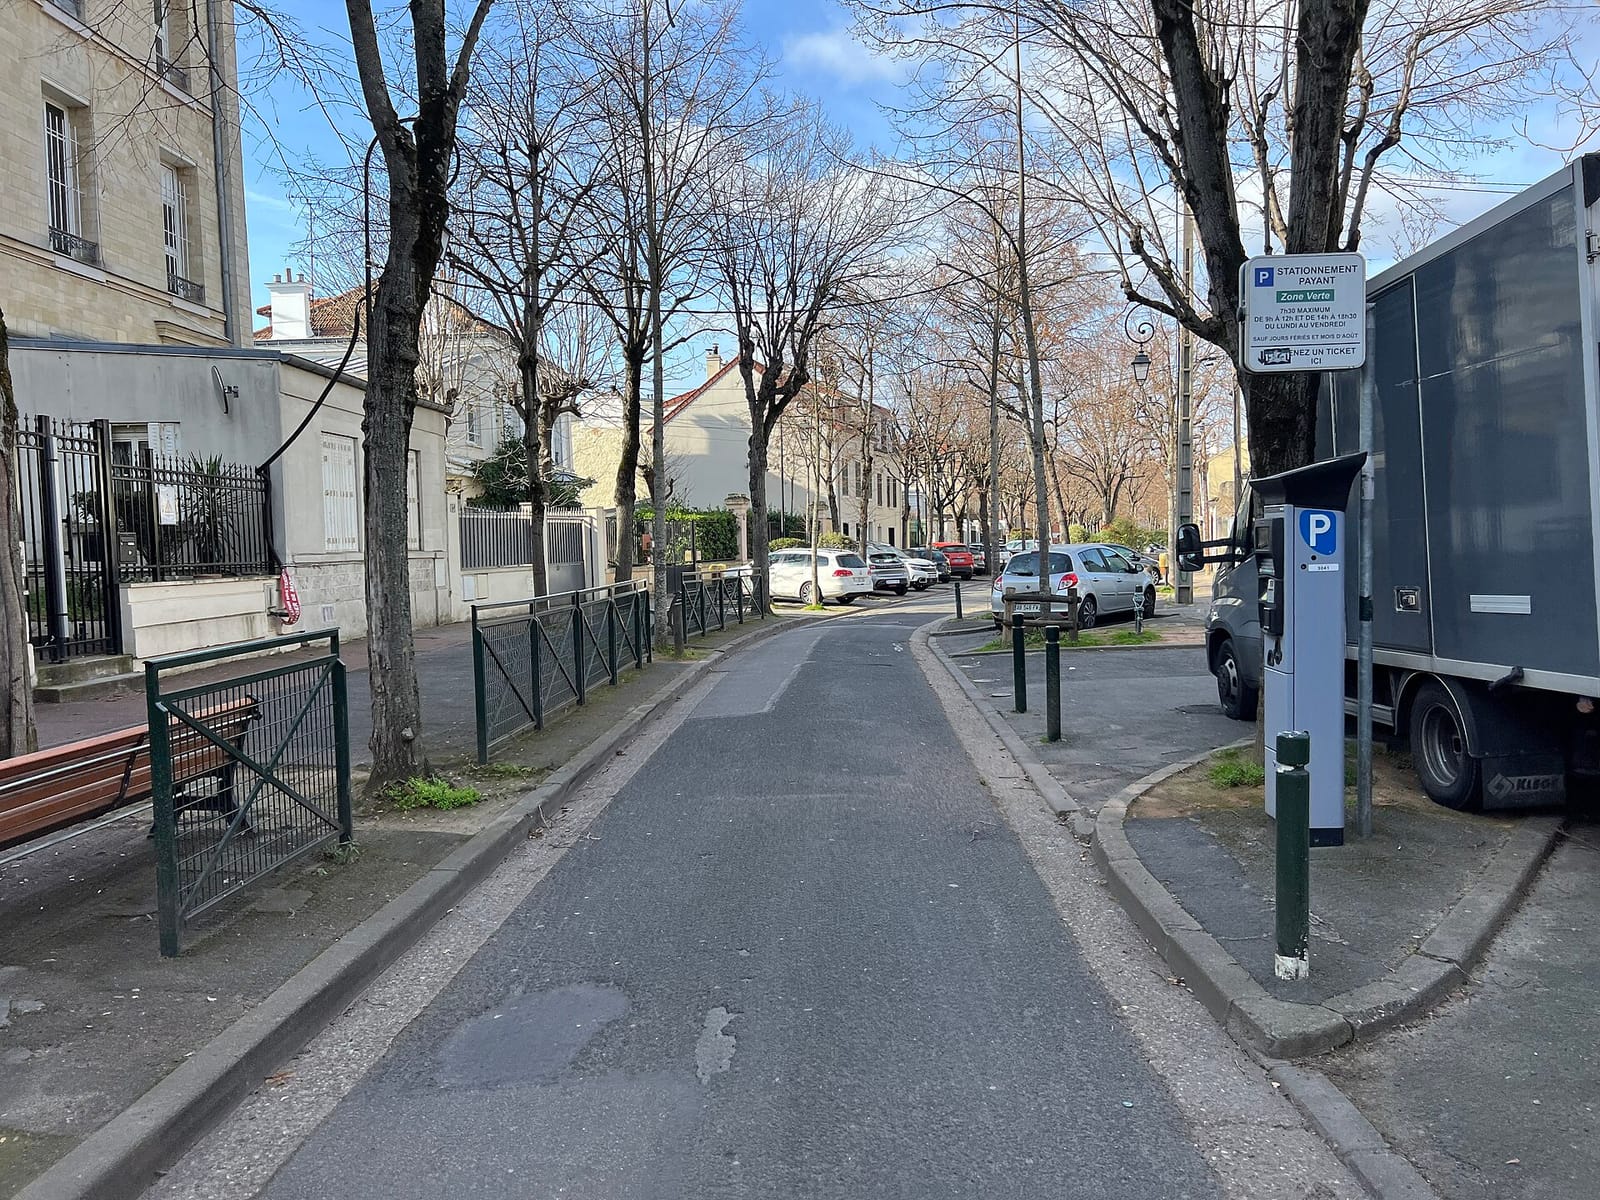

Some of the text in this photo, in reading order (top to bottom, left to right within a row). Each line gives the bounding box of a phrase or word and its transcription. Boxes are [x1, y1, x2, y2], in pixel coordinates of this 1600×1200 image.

[1277, 265, 1358, 275] STATIONNEMENT
[1259, 271, 1269, 283] P
[1299, 276, 1336, 285] PAYANT
[1280, 291, 1330, 301] Zone Verte
[1310, 514, 1331, 547] P
